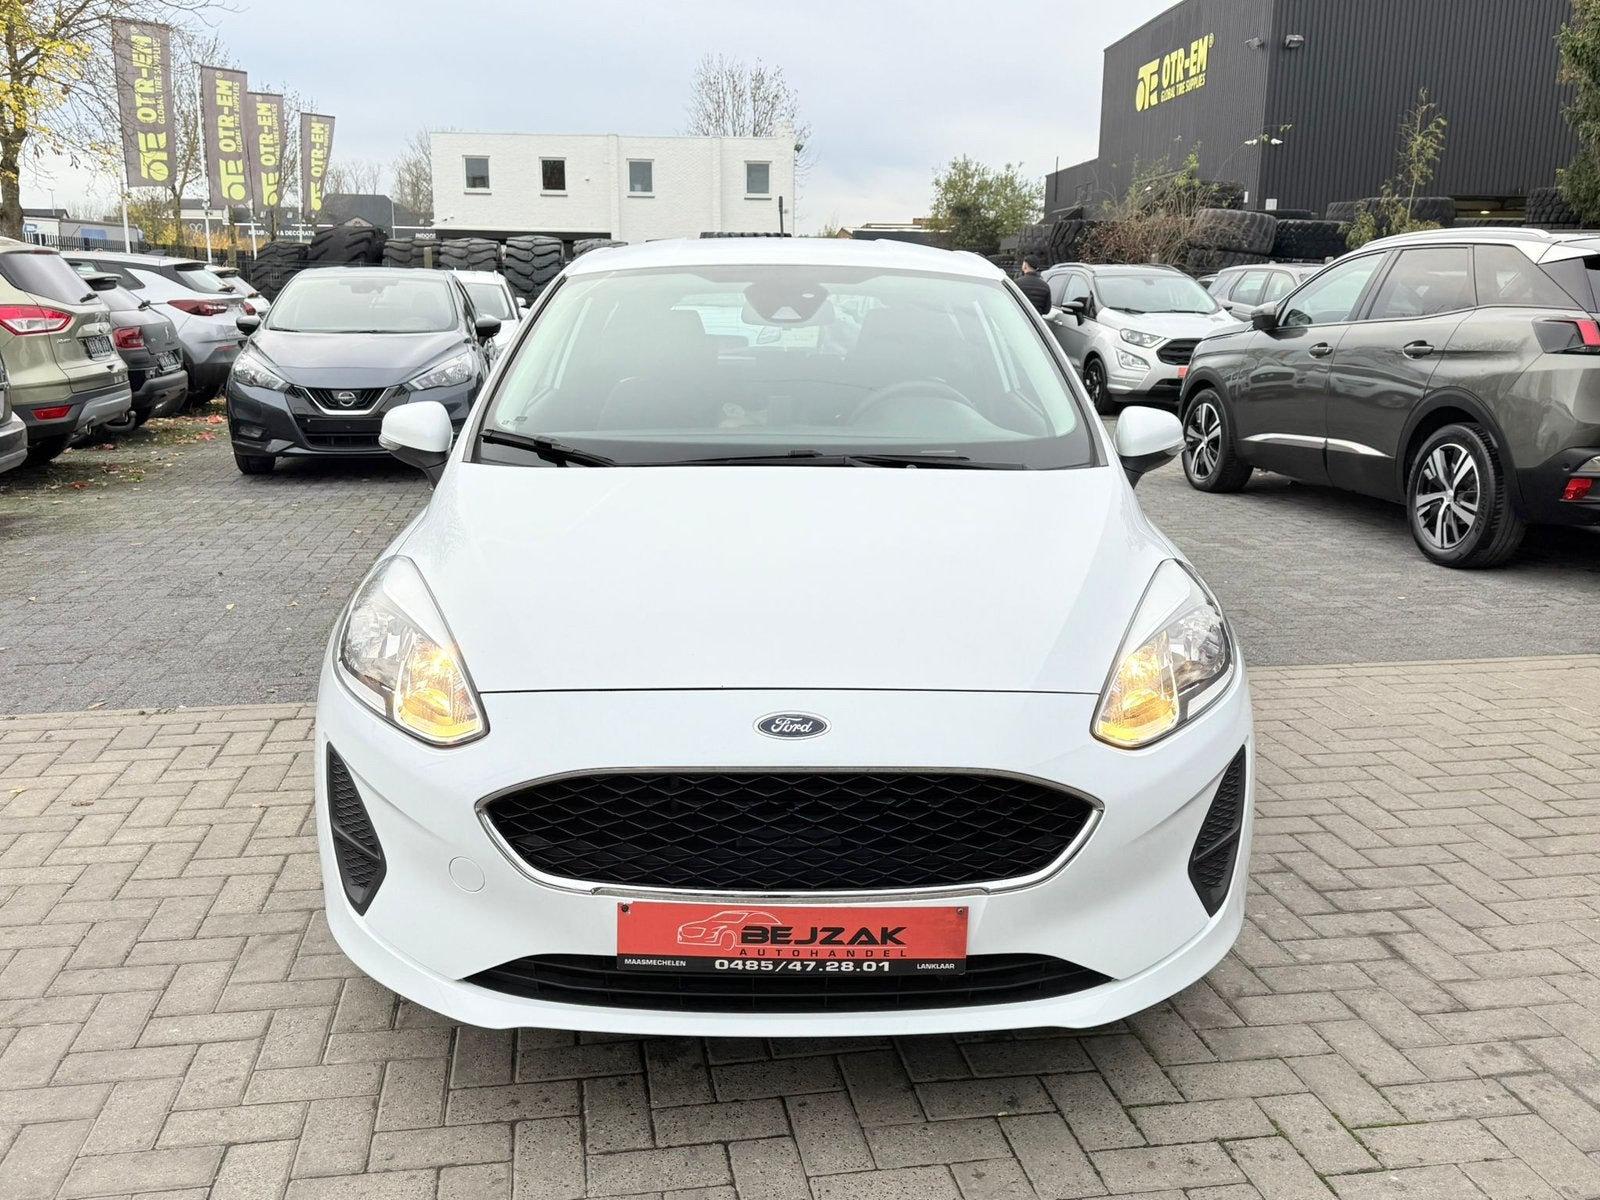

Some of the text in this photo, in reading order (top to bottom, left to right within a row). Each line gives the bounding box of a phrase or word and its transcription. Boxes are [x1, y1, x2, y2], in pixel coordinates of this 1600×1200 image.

[1161, 35, 1209, 89] OTR-EM
[130, 35, 157, 124] OTR-EM
[153, 75, 163, 92] TIRE
[1176, 82, 1186, 96] TIRE
[1186, 73, 1205, 92] SUPPLIES
[155, 95, 165, 124] GLOBAL
[215, 79, 236, 153] OTR-EM
[232, 82, 243, 152] GLOBAL TIRE SUPPLIES
[256, 102, 276, 166] OTR-EM
[310, 122, 324, 177] OTR-EM
[771, 717, 813, 733] Ford
[741, 925, 908, 946] BEJZAK
[624, 958, 687, 967] MAASMECHELEN
[714, 959, 890, 973] 0485/47.28.01
[739, 949, 907, 958] AUTOHANDEL
